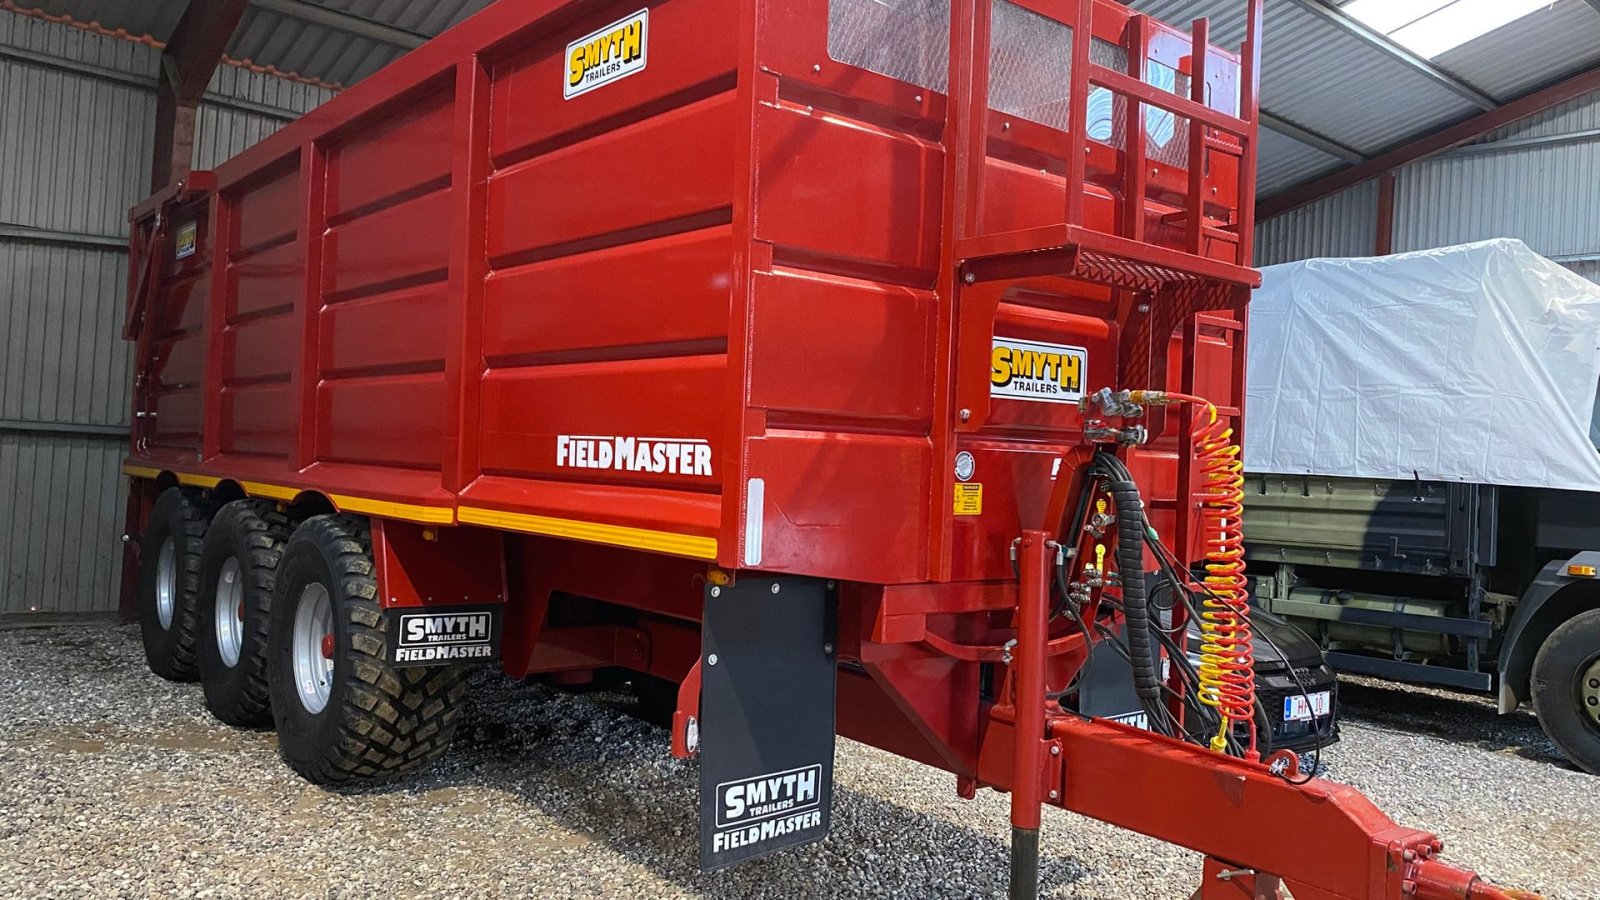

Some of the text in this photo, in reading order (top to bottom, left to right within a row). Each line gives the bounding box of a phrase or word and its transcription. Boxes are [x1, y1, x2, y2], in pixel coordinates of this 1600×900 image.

[569, 19, 642, 87] SMYTH
[585, 61, 621, 84] TRAILERS
[991, 346, 1081, 393] SMYTH
[1013, 381, 1058, 394] TRAILERS
[555, 434, 713, 476] FIELDMASTER
[407, 616, 486, 641] SMYTH
[427, 633, 467, 642] TRAILERS
[395, 645, 492, 662] FIELDMASTER
[725, 769, 816, 819] SMYTH
[749, 799, 794, 817] TRAILERS
[713, 809, 821, 853] FIELDMASTER
